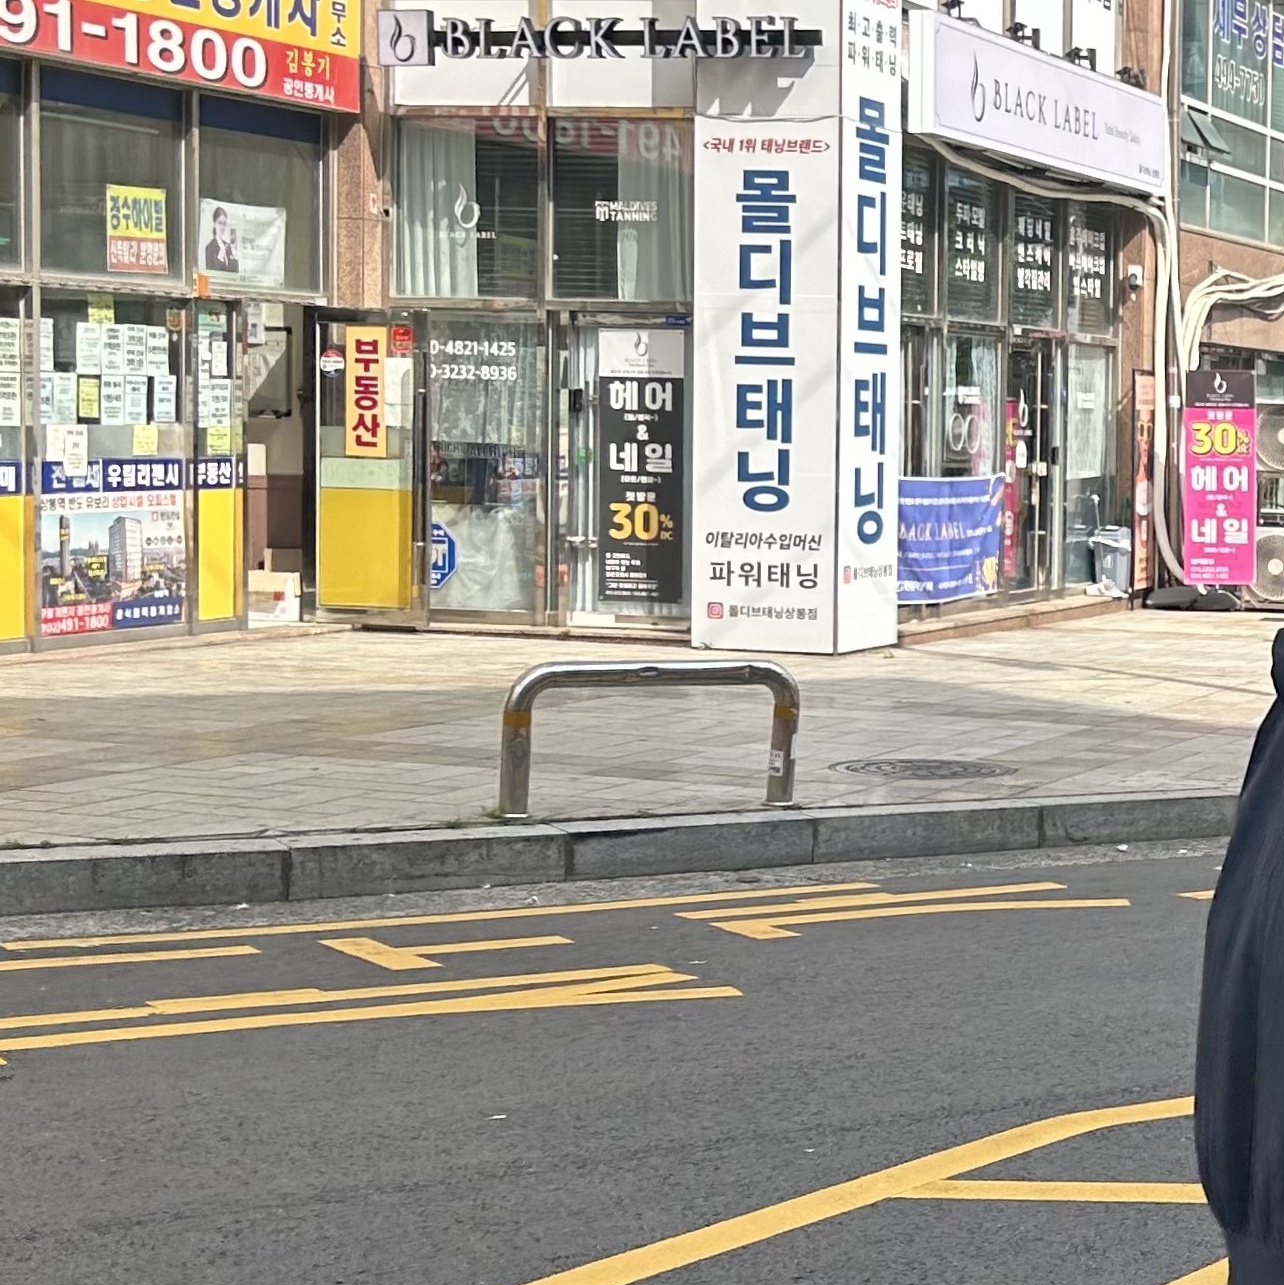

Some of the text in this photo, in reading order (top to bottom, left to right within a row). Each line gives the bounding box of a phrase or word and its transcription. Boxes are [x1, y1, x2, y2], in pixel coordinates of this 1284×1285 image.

[442, 15, 814, 60] BLACK LABEL
[285, 48, 331, 80] 김봉기
[283, 77, 335, 103] 공인중개사
[993, 78, 1048, 126] BLACK
[1054, 101, 1099, 142] LABEL
[739, 138, 757, 153] 1위
[609, 201, 658, 212] MALDIVES
[610, 211, 658, 222] TANNING
[470, 231, 496, 240] LABEL
[854, 95, 890, 545] 몰디브태닝
[735, 169, 797, 512] 몰디브태닝
[352, 338, 380, 448] 부동산
[608, 380, 673, 411] 헤어
[637, 424, 649, 440] &
[608, 442, 673, 473] 네일
[1190, 465, 1249, 491] 헤어
[705, 531, 822, 551] 이탈리아수입머신
[1190, 518, 1249, 544] 네일
[709, 560, 819, 590] 파워태닝
